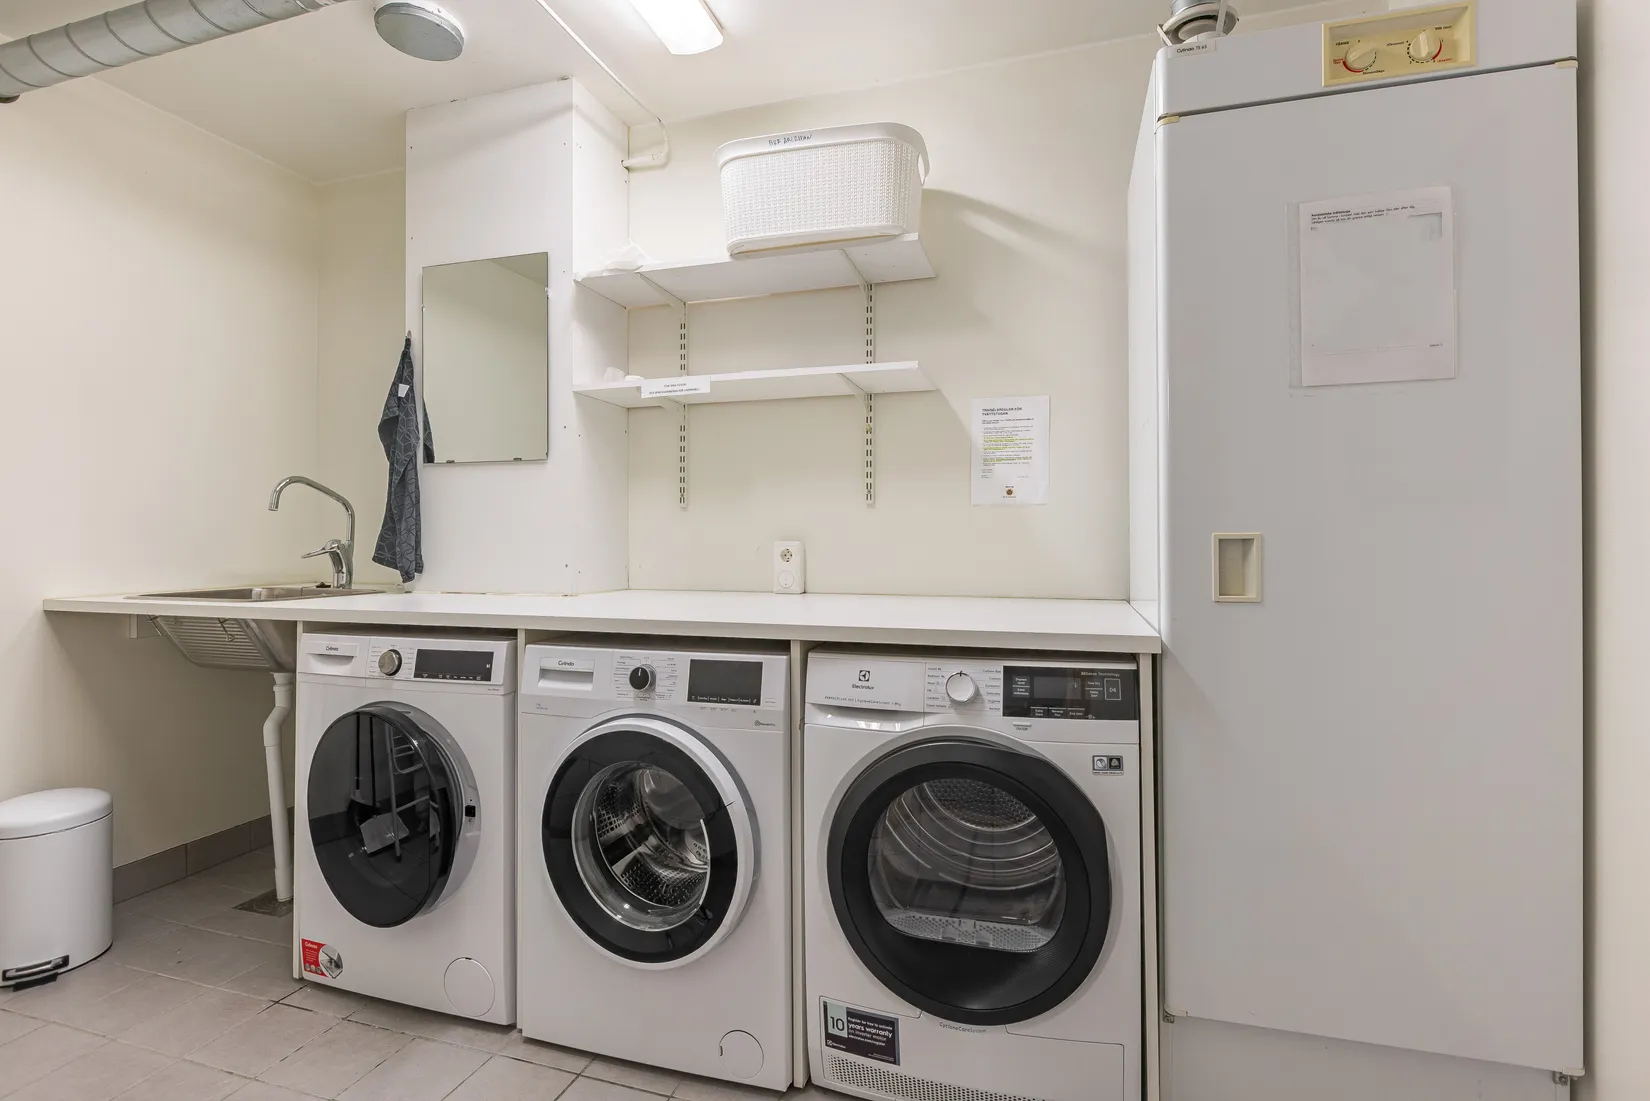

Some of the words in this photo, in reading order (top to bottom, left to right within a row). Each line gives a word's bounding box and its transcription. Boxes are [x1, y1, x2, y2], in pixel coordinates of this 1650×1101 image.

[830, 1016, 845, 1031] 10
[848, 1023, 864, 1031] years
[866, 1027, 892, 1038] warranty
